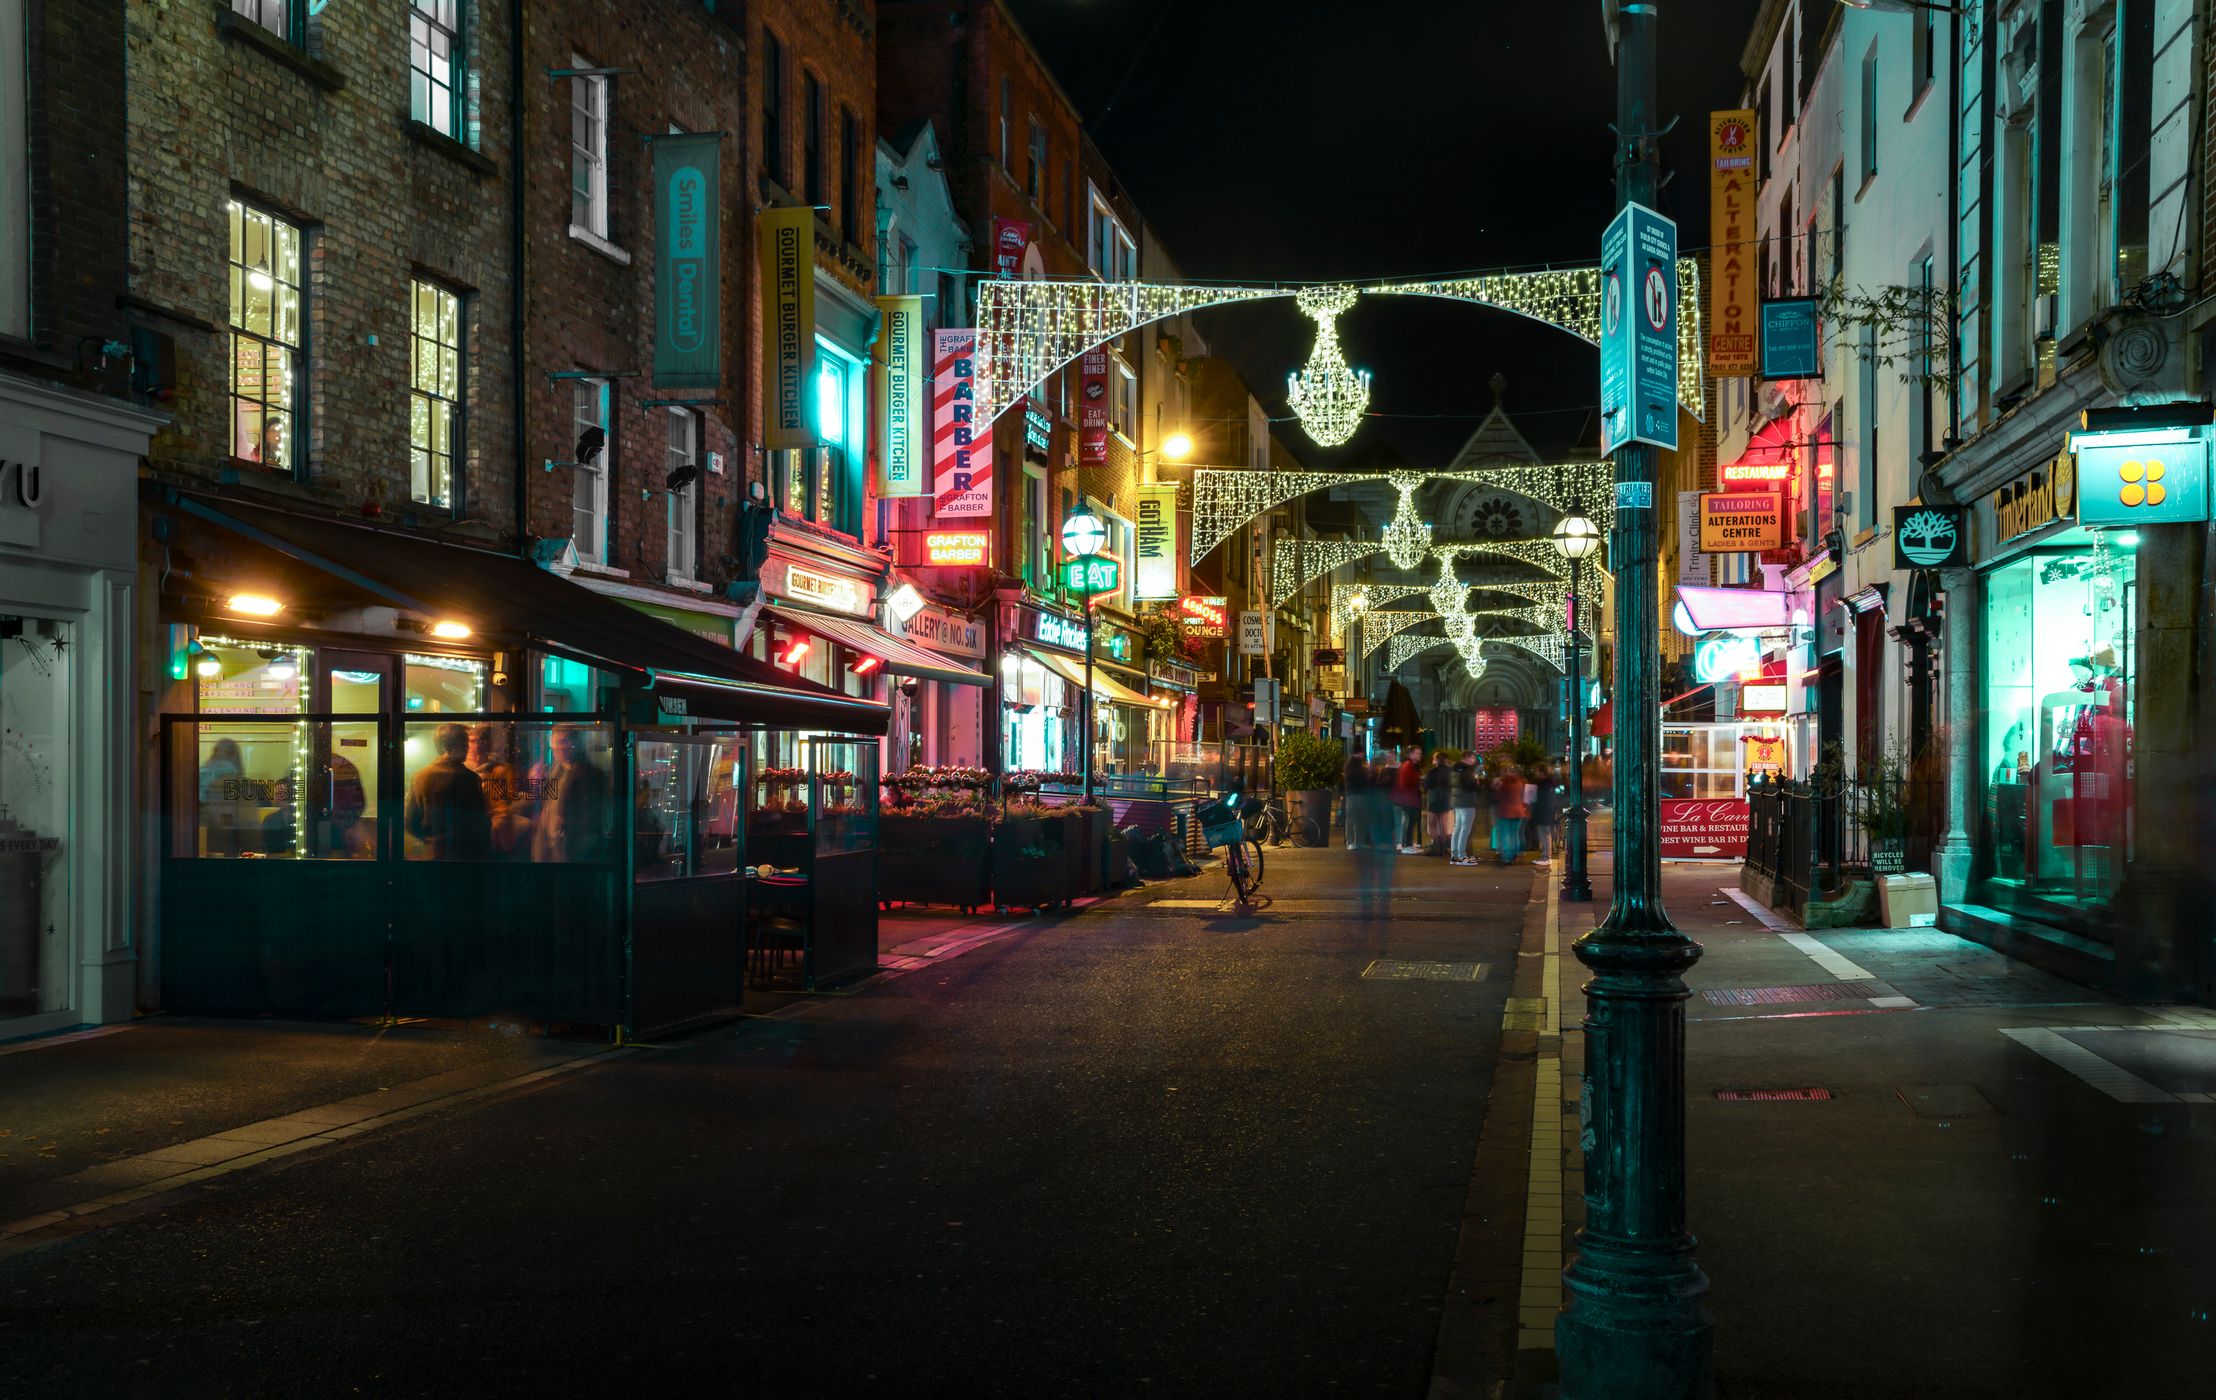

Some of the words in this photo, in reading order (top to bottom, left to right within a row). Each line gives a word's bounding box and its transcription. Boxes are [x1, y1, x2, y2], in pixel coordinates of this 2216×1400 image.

[1714, 117, 1751, 135] ALTERATION
[1716, 158, 1751, 169] TAILORING
[680, 179, 697, 250] Smiles
[780, 227, 795, 299] GOURMET
[1724, 178, 1742, 334] ALTERATION
[678, 263, 698, 337] Dental
[782, 299, 797, 361] BURGER
[1768, 319, 1809, 329] CHIFFON
[891, 311, 905, 369] GOURMET
[939, 335, 947, 353] THE
[1714, 337, 1751, 351] CENTRE
[1084, 354, 1106, 364] FINER
[1084, 365, 1106, 375] DINER
[783, 364, 799, 430] KITCHEN
[892, 373, 905, 424] BURGER
[1088, 410, 1101, 419] EAT
[953, 358, 973, 491] BARBER
[1083, 419, 1105, 428] DRINK
[892, 427, 906, 482] KITCHEN
[939, 494, 947, 511] THE
[946, 493, 988, 501] GRAFTON
[1713, 499, 1770, 511] TAILORING
[1993, 459, 2054, 542] Timberland
[947, 503, 984, 511] BARBER
[1139, 500, 1169, 558] GOTHAM
[1689, 510, 1700, 537] Clinic
[1708, 514, 1777, 527] ALTERATIONS
[927, 535, 986, 547] GRAFTON
[1722, 527, 1761, 538] CENTRE
[1707, 540, 1736, 548] LADIES
[1748, 539, 1776, 547] GENTS
[930, 548, 982, 561] BARBER
[791, 572, 817, 592] GOURMET
[1070, 562, 1117, 588] EAT
[1202, 597, 1226, 606] WINES
[1038, 611, 1061, 644] Eddie
[1243, 616, 1270, 625] COSMC
[950, 624, 964, 645] NO.
[965, 628, 977, 649] SIX
[1185, 626, 1223, 637] OUNGE
[1245, 628, 1263, 638] DOCTO
[224, 779, 311, 802] BUNSE
[479, 778, 559, 801] UNSEN
[1667, 802, 1703, 823] La
[1708, 824, 1748, 832] RESTAUR
[8, 839, 38, 850] EVERY
[39, 838, 59, 849] DAY
